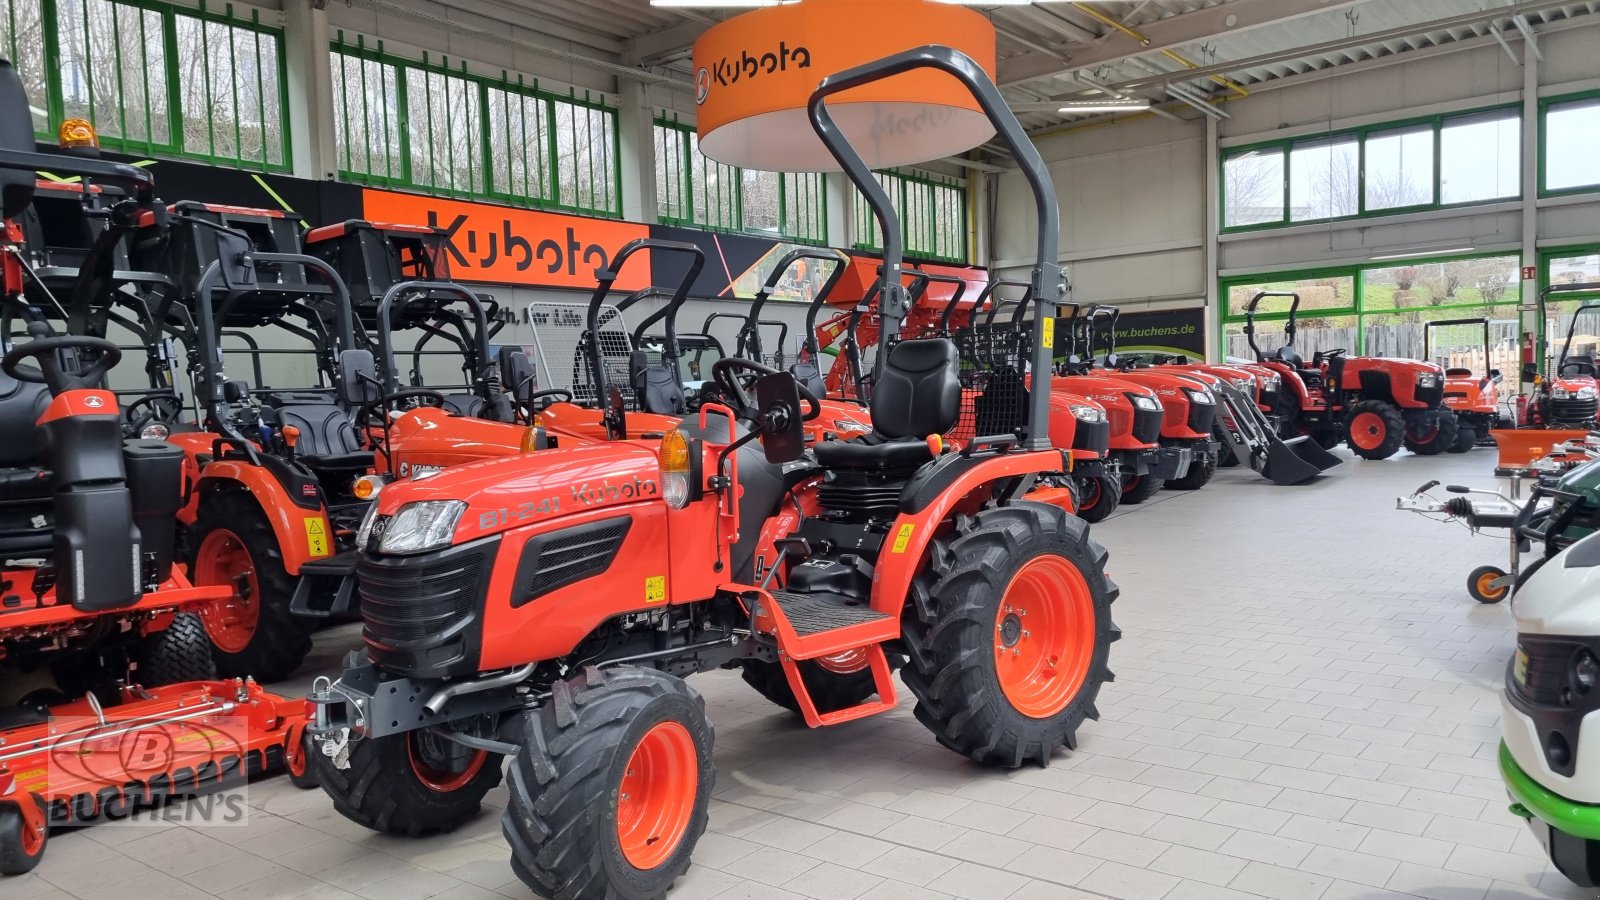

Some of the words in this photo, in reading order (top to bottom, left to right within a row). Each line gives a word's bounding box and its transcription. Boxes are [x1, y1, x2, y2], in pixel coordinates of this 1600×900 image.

[713, 41, 811, 86] Kubota
[427, 211, 609, 276] Kubota
[571, 475, 657, 506] Kubota
